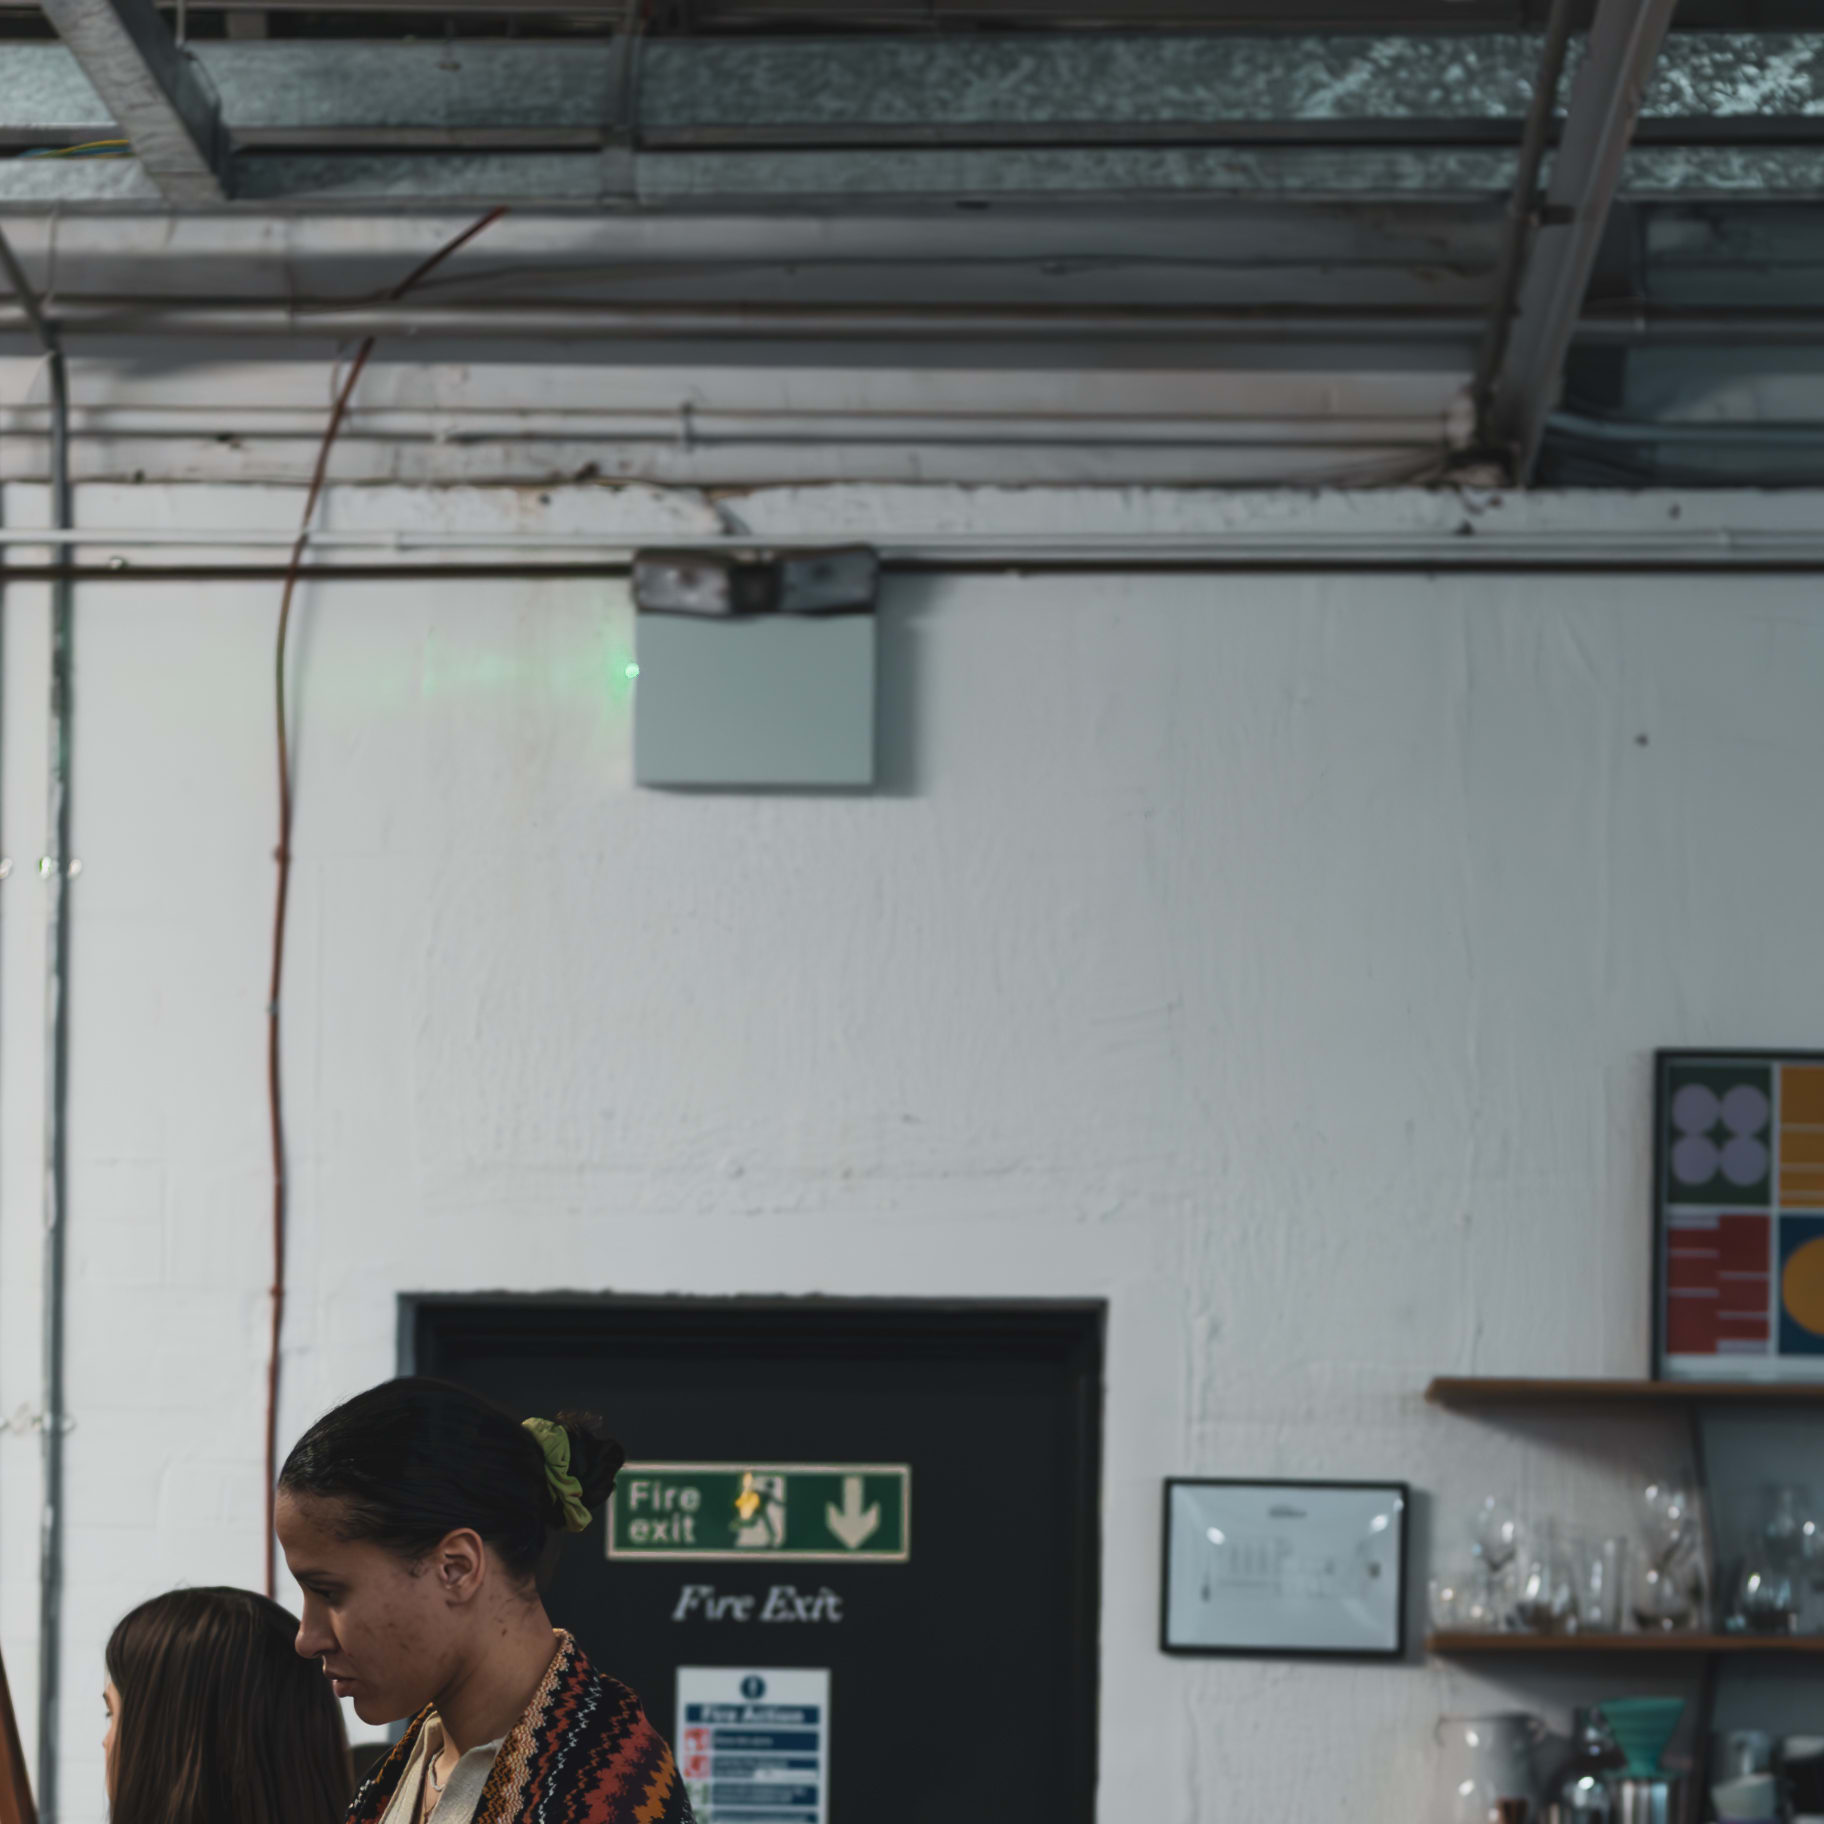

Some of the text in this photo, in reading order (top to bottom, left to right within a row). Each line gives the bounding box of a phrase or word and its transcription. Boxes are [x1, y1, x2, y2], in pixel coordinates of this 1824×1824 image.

[629, 1480, 702, 1512] Fire
[629, 1514, 696, 1544] exit
[670, 1584, 844, 1623] Fire Exit
[699, 1704, 806, 1721] Fire Action
